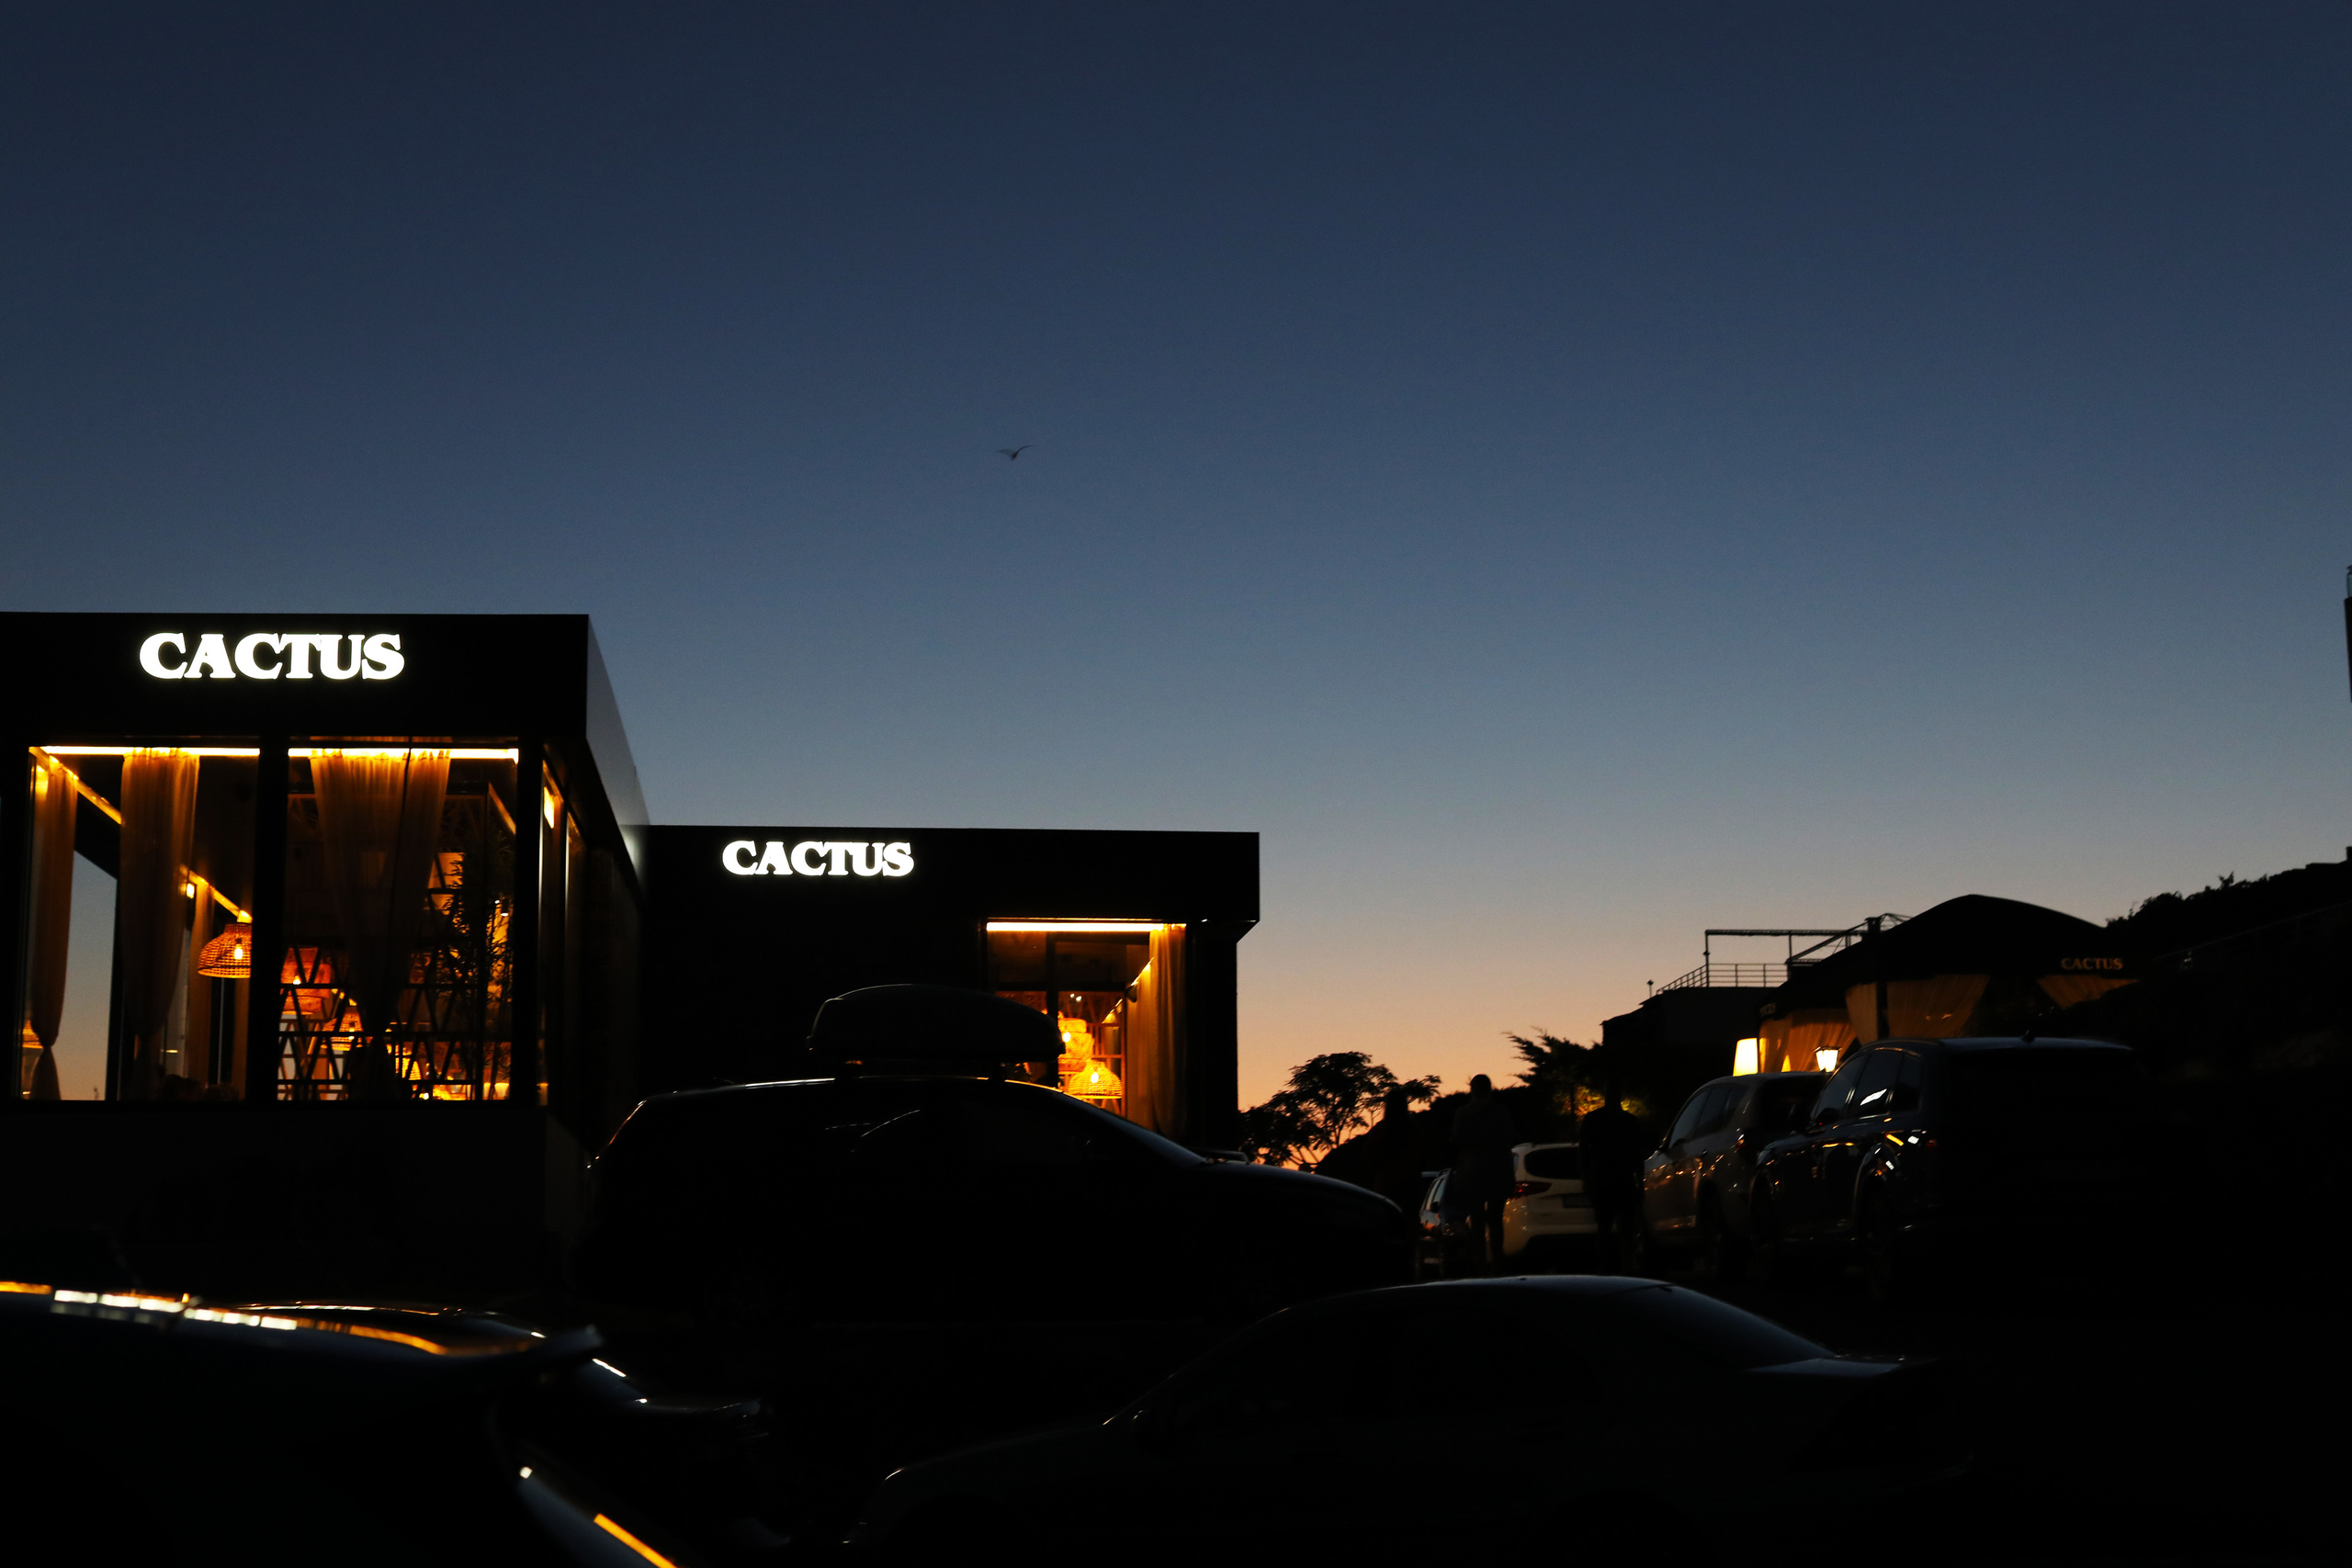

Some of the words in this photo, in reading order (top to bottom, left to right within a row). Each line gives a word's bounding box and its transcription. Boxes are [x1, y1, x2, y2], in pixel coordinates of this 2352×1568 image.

[139, 632, 405, 681] CACTUS
[722, 840, 915, 877] CACTUS
[2061, 957, 2123, 970] CACTUS
